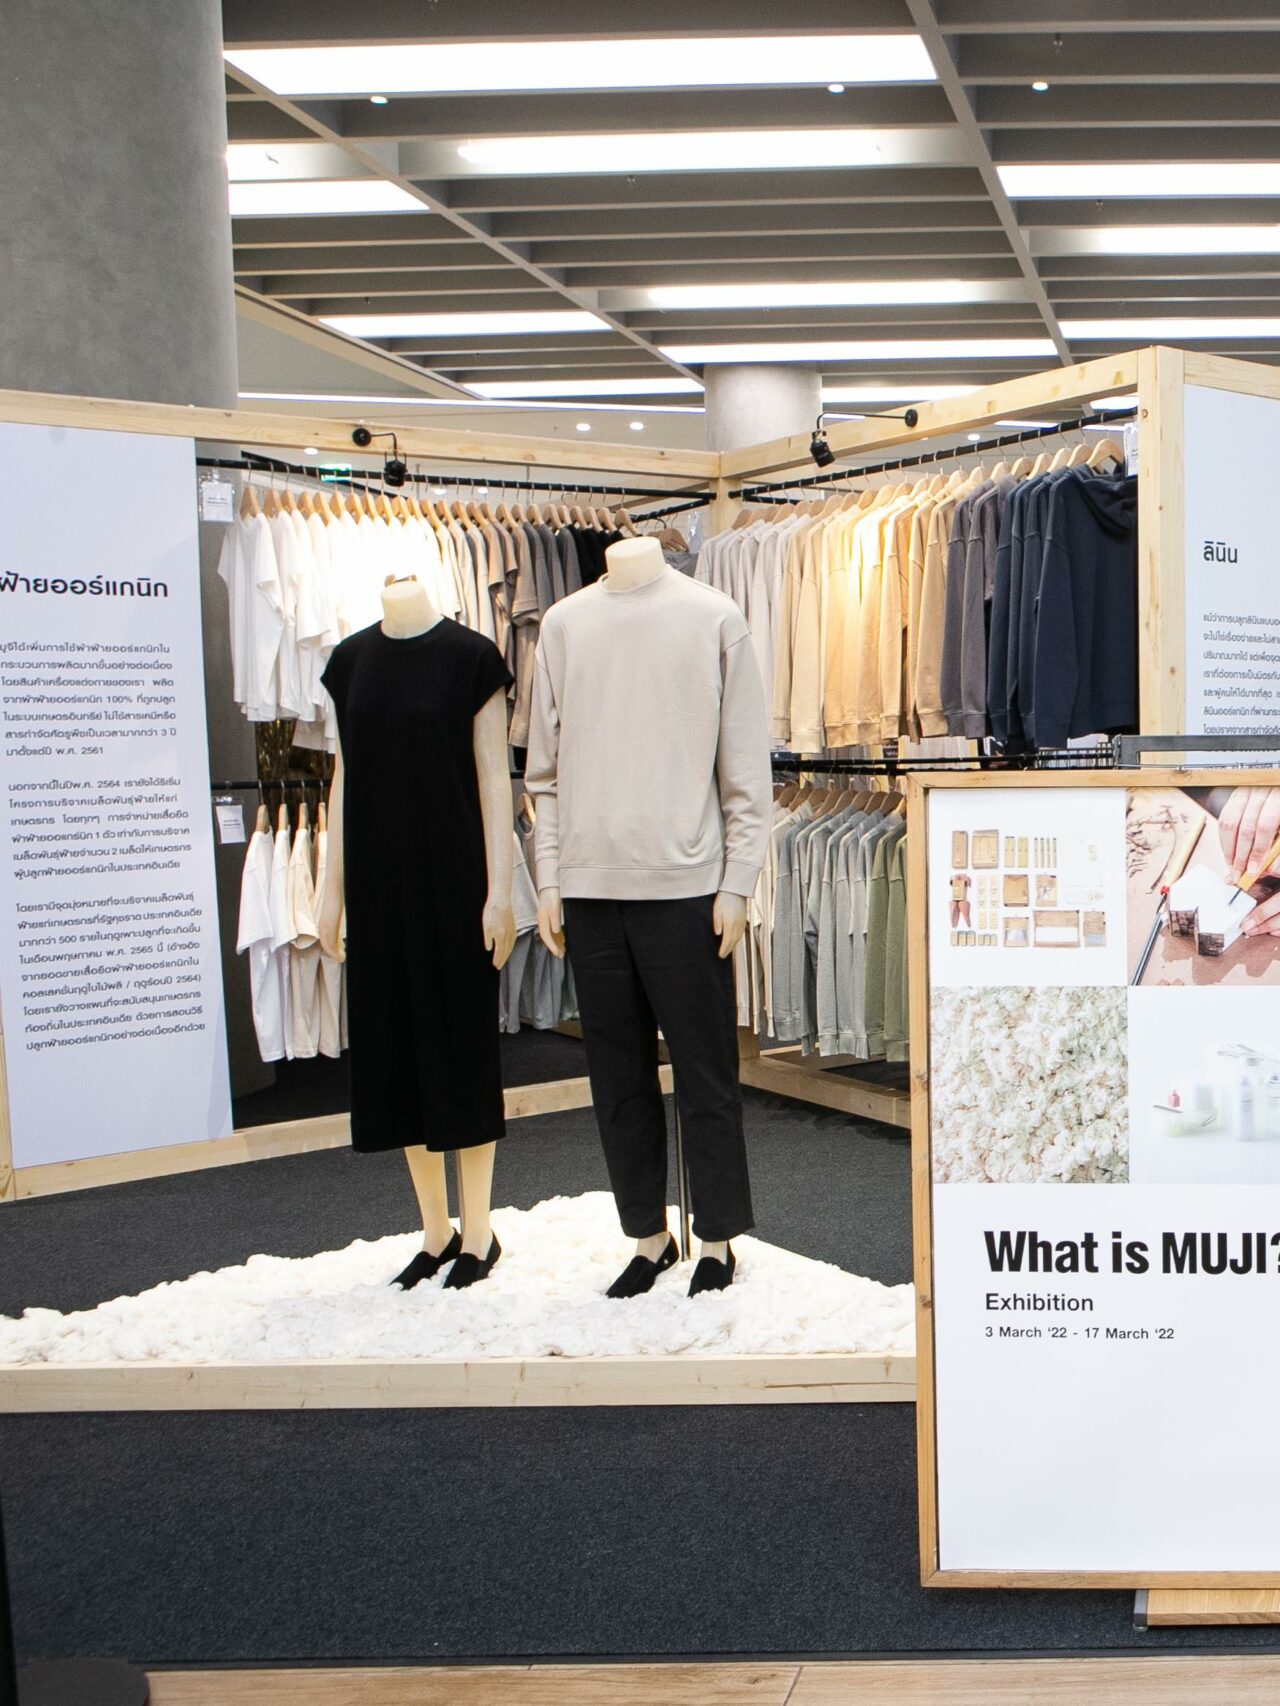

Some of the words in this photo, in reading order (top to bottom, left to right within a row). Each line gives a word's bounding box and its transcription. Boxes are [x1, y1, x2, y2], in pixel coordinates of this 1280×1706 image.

[1203, 540, 1238, 563] ลินิน
[0, 571, 168, 597] ฝ้ายออร์แกนิก
[107, 695, 132, 704] 100%
[161, 729, 168, 737] 3
[170, 728, 177, 737] ปี
[81, 746, 104, 754] 2561
[97, 780, 121, 789] 2564
[10, 816, 55, 826] เกษตรกร
[112, 847, 118, 855] 2
[59, 935, 77, 944] 500
[131, 945, 153, 955] 2565
[984, 1231, 1098, 1273] What
[1112, 1232, 1149, 1274] is
[986, 1293, 1093, 1311] Exhibition
[985, 1326, 993, 1338] 3
[999, 1326, 1042, 1338] March
[1085, 1327, 1100, 1338] 17
[1105, 1327, 1149, 1339] March
